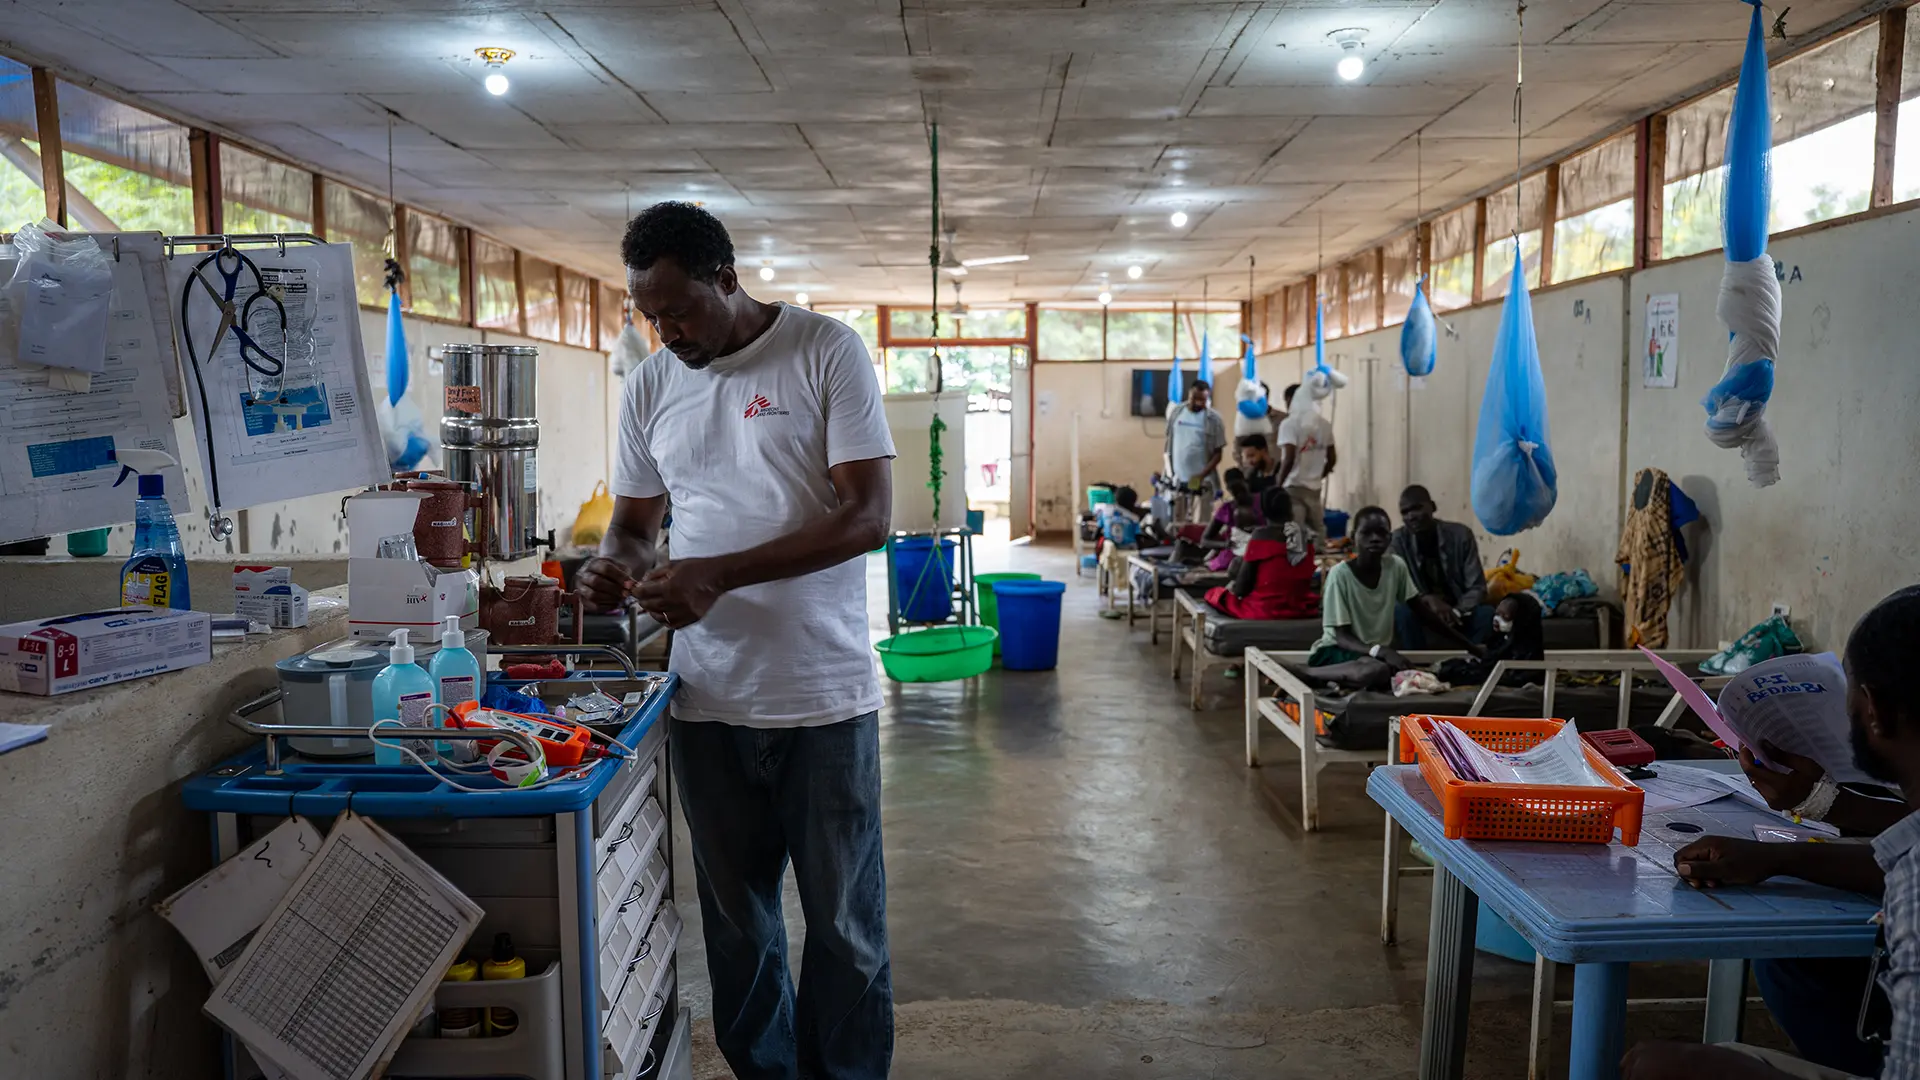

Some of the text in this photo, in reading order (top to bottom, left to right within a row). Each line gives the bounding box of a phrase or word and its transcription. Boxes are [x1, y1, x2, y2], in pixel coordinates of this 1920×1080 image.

[1788, 265, 1802, 284] A
[153, 575, 168, 605] FLAG
[57, 643, 76, 658] 8-9
[63, 659, 70, 672] L
[1746, 686, 1781, 704] BED
